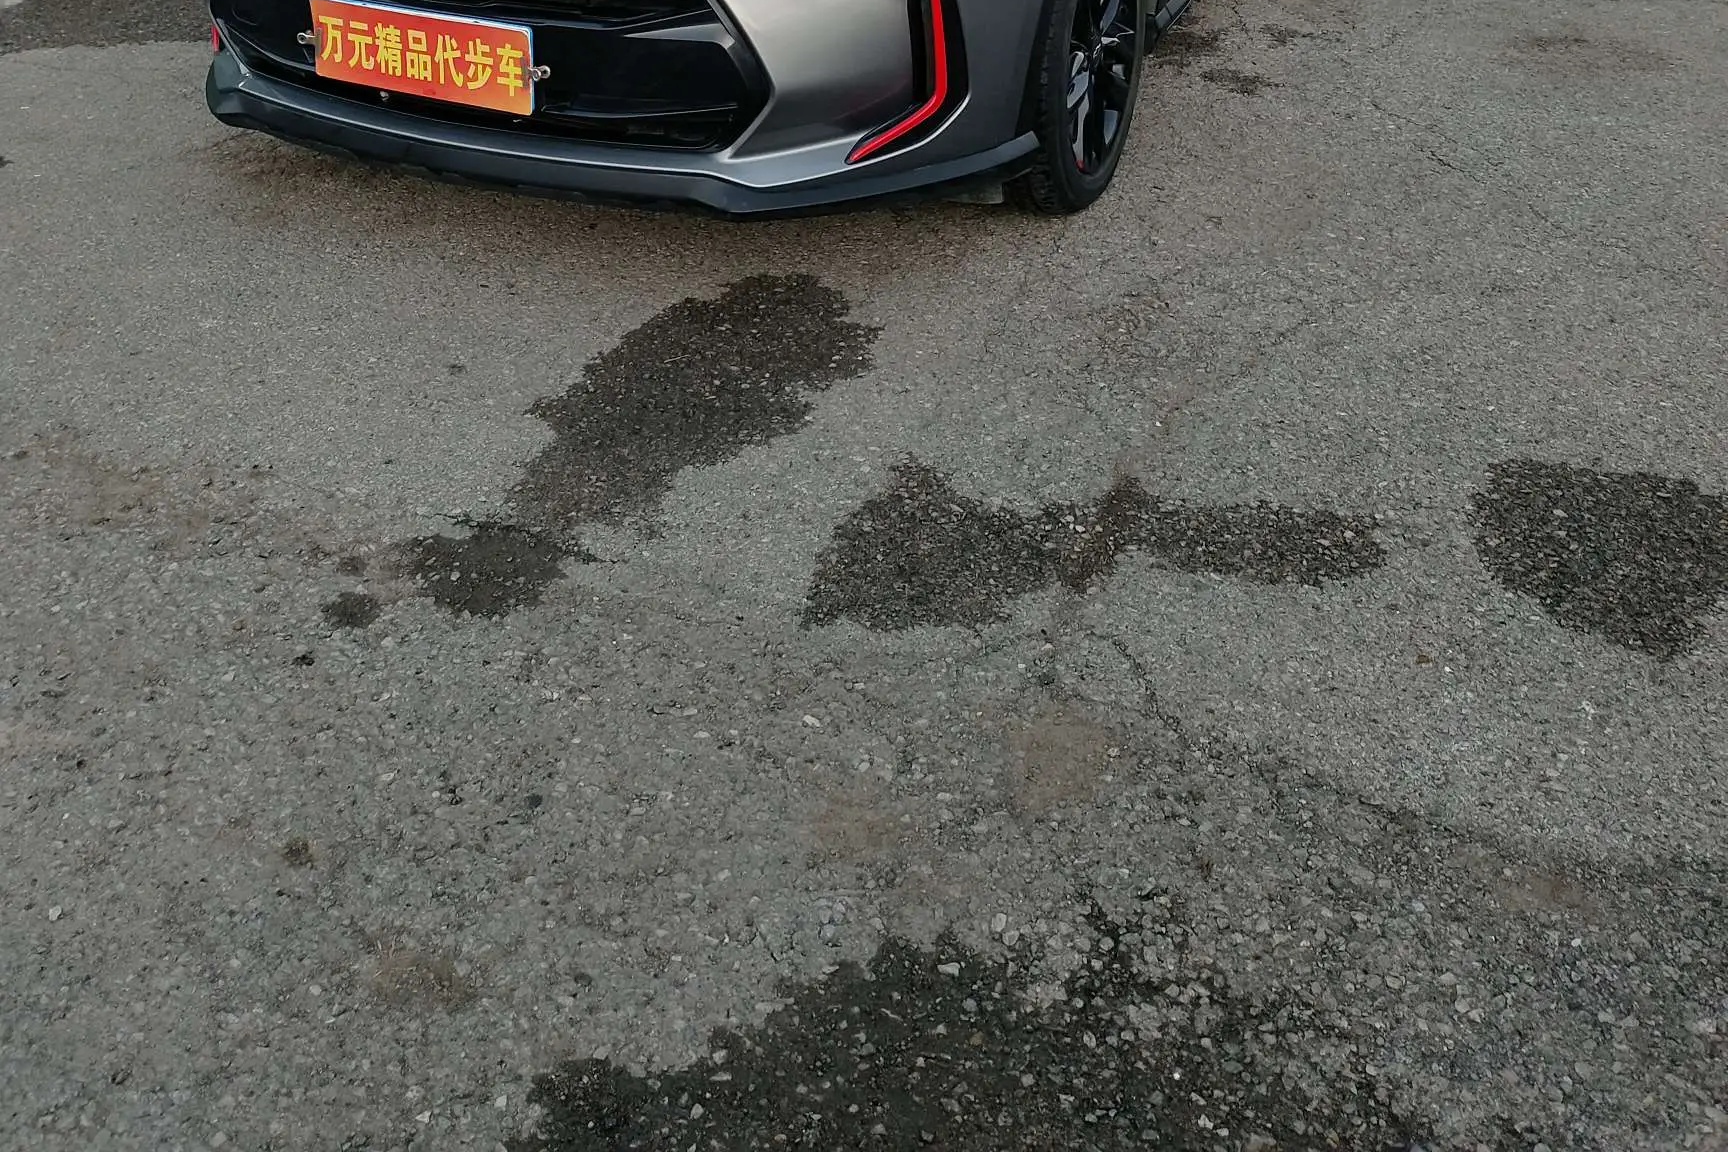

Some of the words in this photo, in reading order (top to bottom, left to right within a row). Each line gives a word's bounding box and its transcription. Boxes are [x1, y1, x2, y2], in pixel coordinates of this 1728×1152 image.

[318, 15, 525, 97] 万元精品代步车
